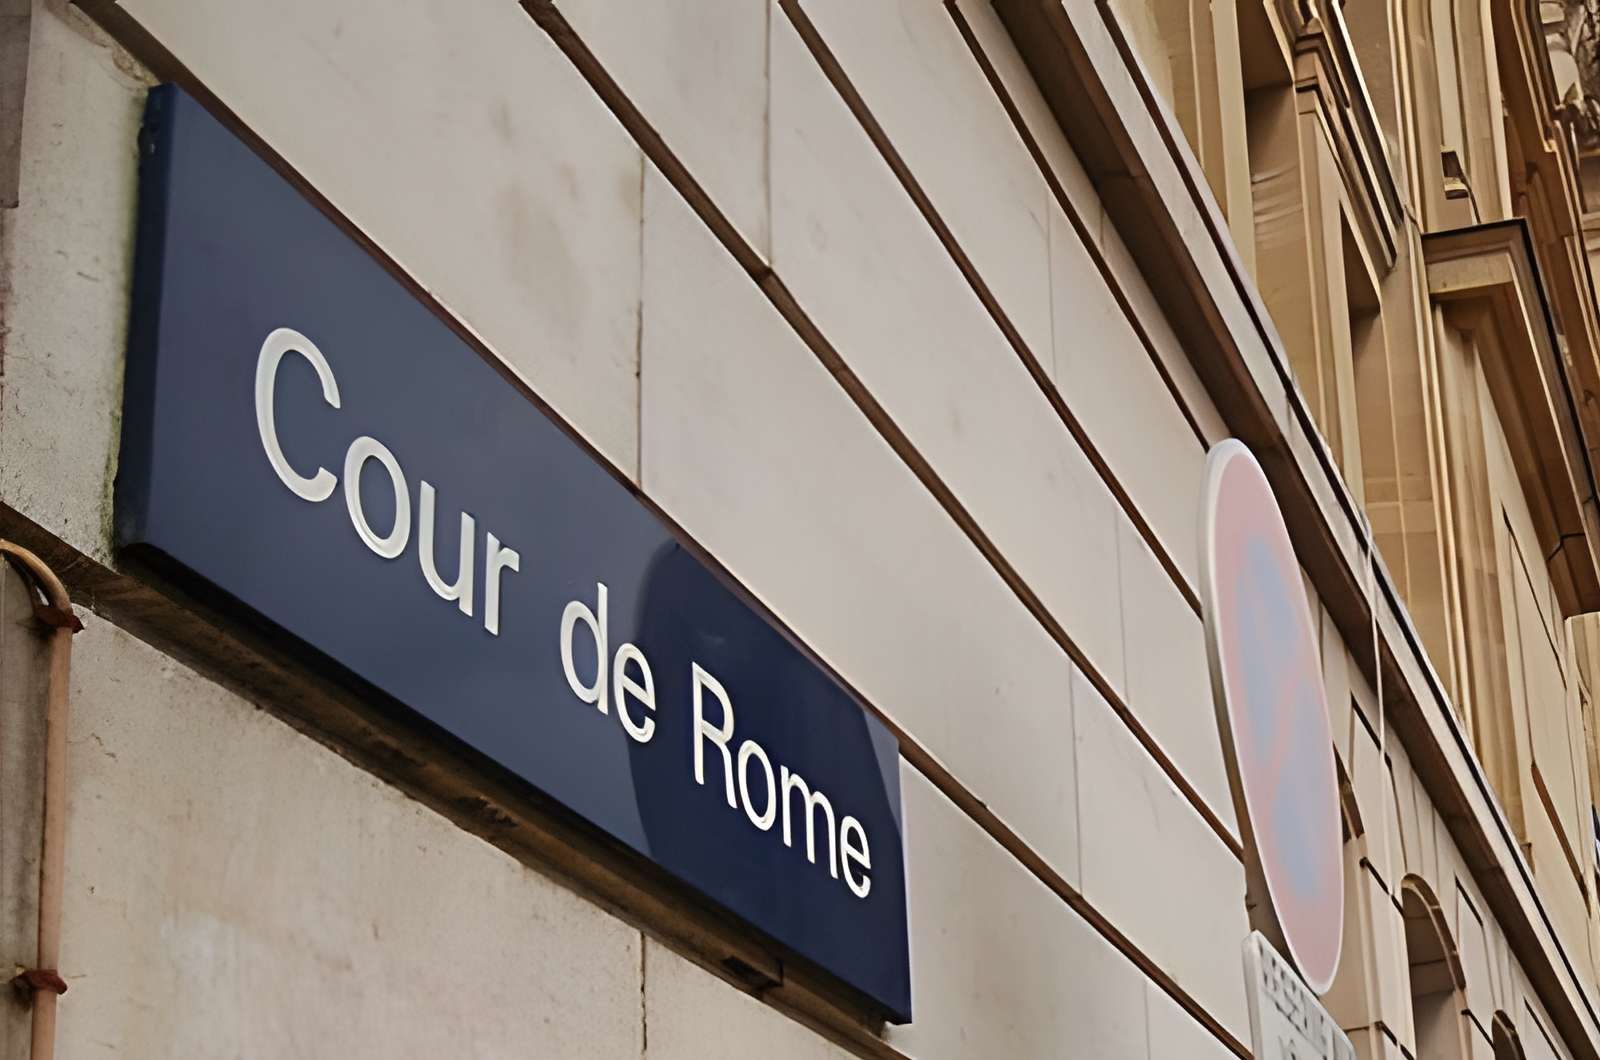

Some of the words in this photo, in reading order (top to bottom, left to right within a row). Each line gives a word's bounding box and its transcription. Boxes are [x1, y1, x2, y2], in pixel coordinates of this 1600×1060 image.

[255, 327, 521, 636] Cour
[560, 582, 657, 744] de
[692, 661, 872, 900] Rome
